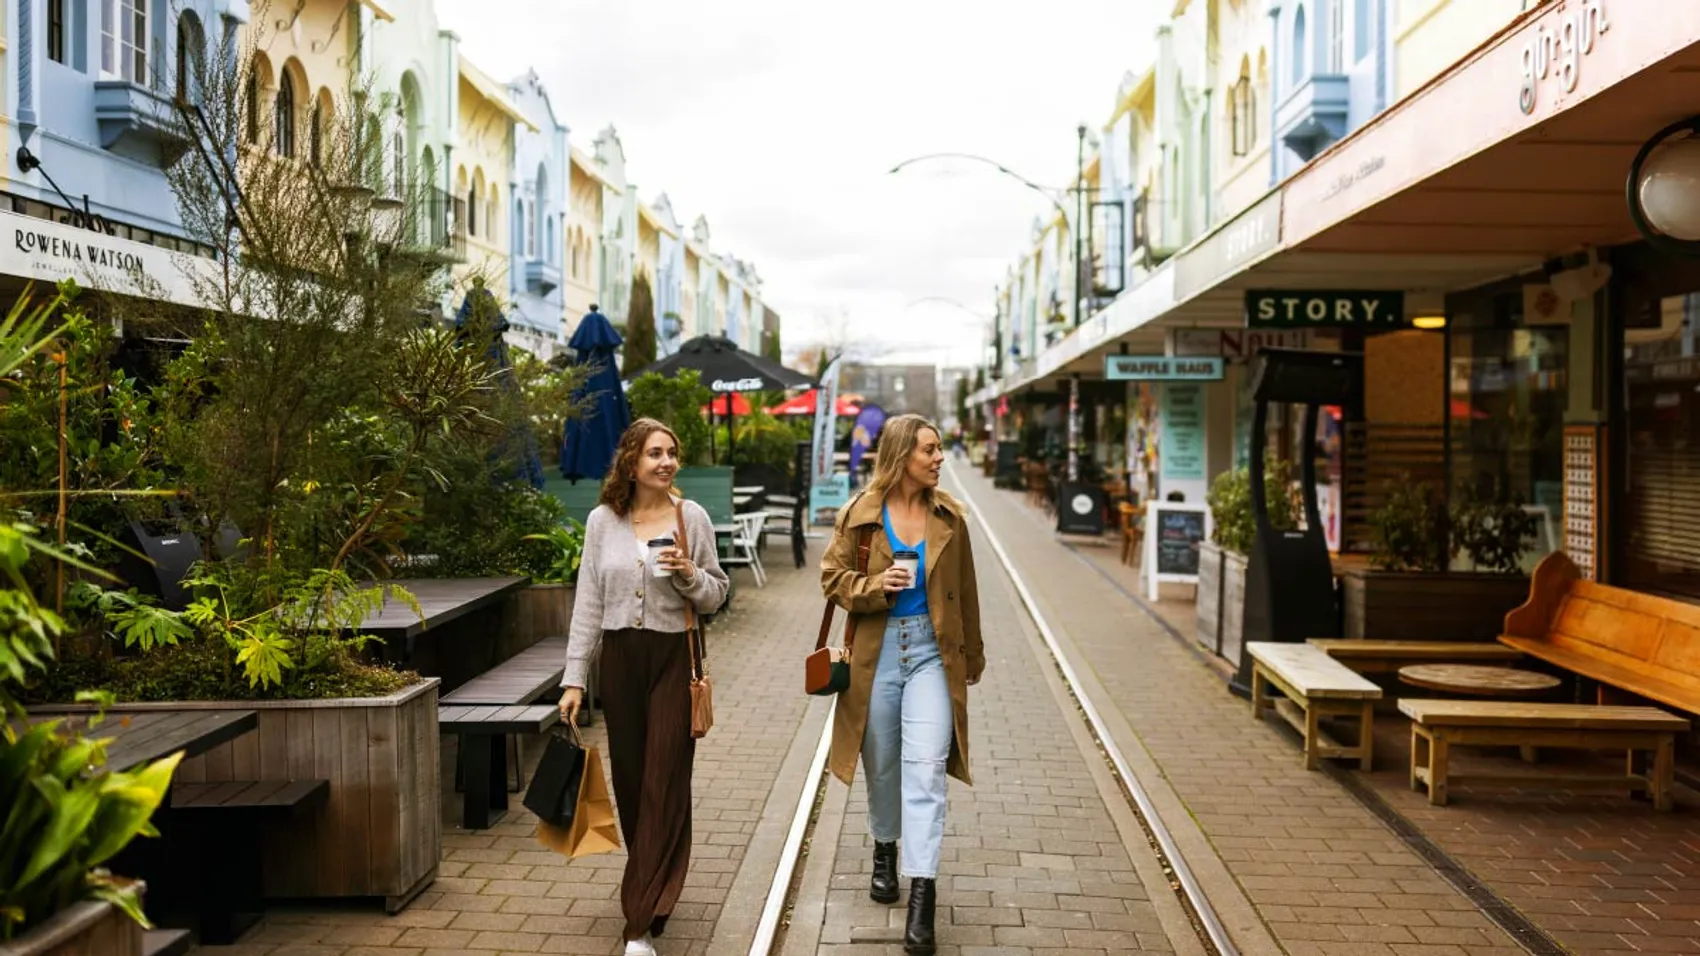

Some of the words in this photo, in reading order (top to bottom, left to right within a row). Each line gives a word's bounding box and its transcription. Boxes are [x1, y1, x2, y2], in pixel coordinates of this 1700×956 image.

[15, 229, 82, 261] ROWENA
[87, 245, 144, 274] WATSON
[1258, 298, 1394, 321] STORY.
[1116, 361, 1170, 375] WAFFLE
[1175, 361, 1215, 375] HAUS
